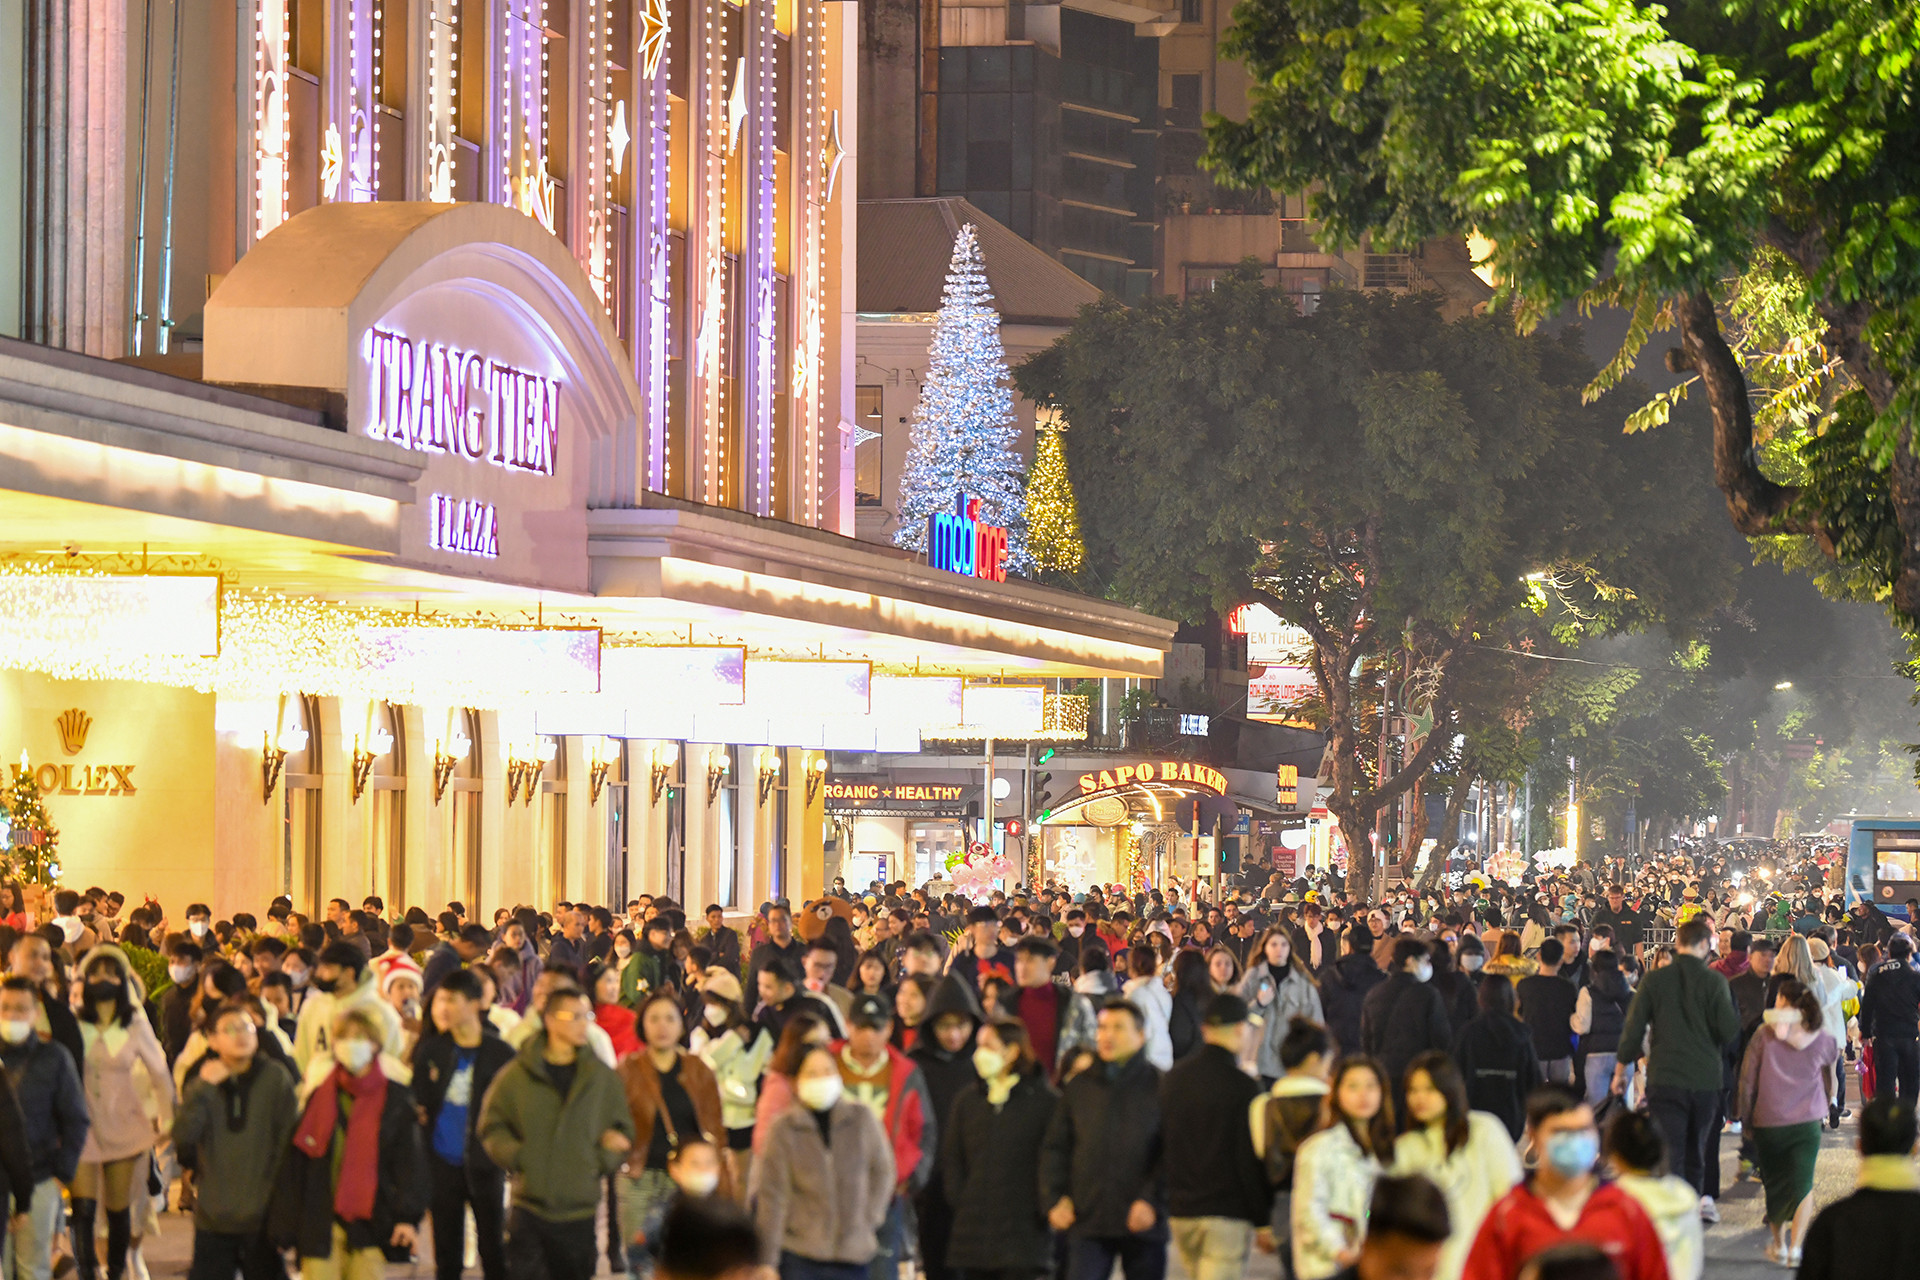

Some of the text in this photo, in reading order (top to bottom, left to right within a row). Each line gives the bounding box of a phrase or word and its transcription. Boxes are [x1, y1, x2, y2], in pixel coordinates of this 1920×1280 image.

[365, 323, 561, 477] TRANG TIEN
[429, 493, 500, 558] PLAZA
[895, 786, 963, 800] HEALTHY
[1079, 761, 1230, 797] SAPO BAKERY
[315, 1025, 328, 1051] A
